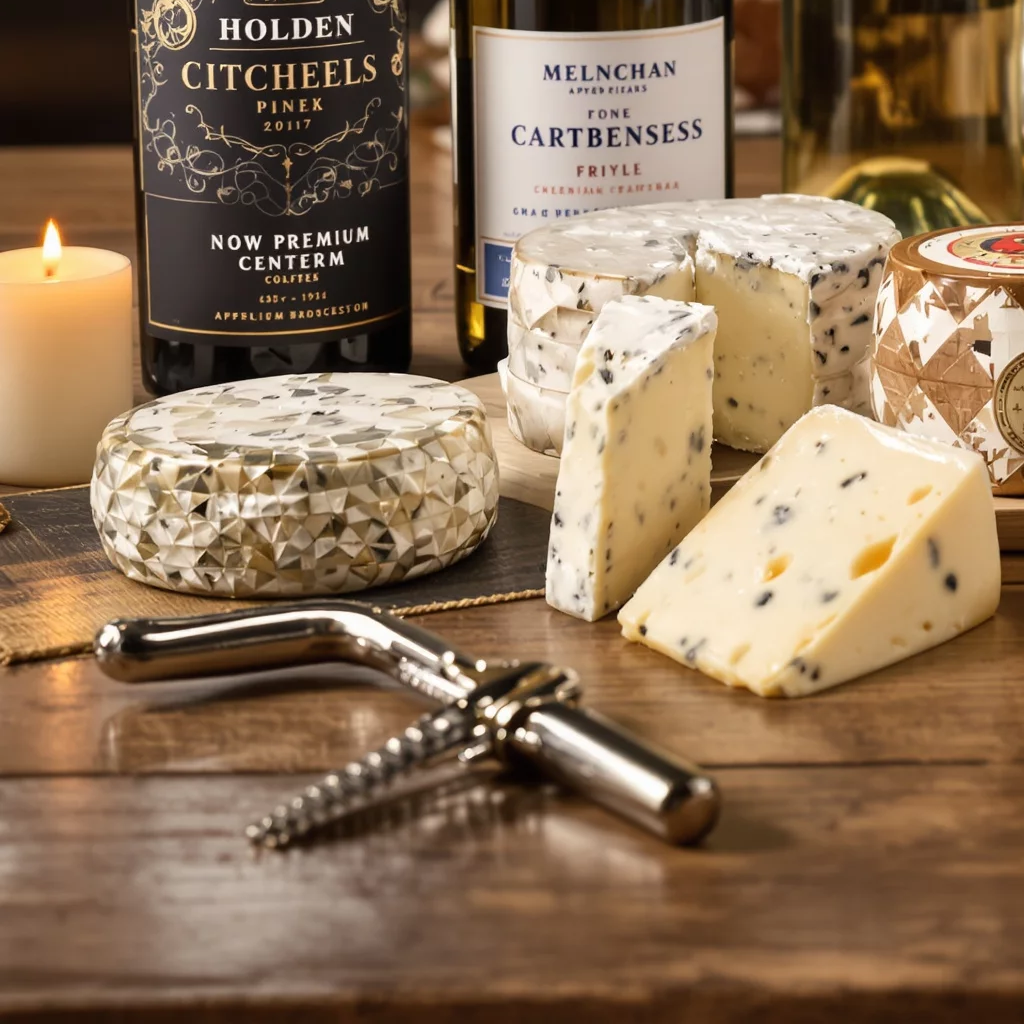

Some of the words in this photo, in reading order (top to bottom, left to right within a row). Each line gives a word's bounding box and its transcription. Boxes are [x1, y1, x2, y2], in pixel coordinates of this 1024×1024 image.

[218, 12, 355, 42] HOLDEN
[181, 53, 378, 93] CITCHEELS
[542, 59, 678, 83] MELNCHAN
[510, 117, 704, 149] CARTBENSESS
[576, 162, 643, 179] FRIYLE
[210, 233, 263, 251] NOW
[273, 225, 370, 250] PREMIUM
[238, 250, 345, 271] CENTERM
